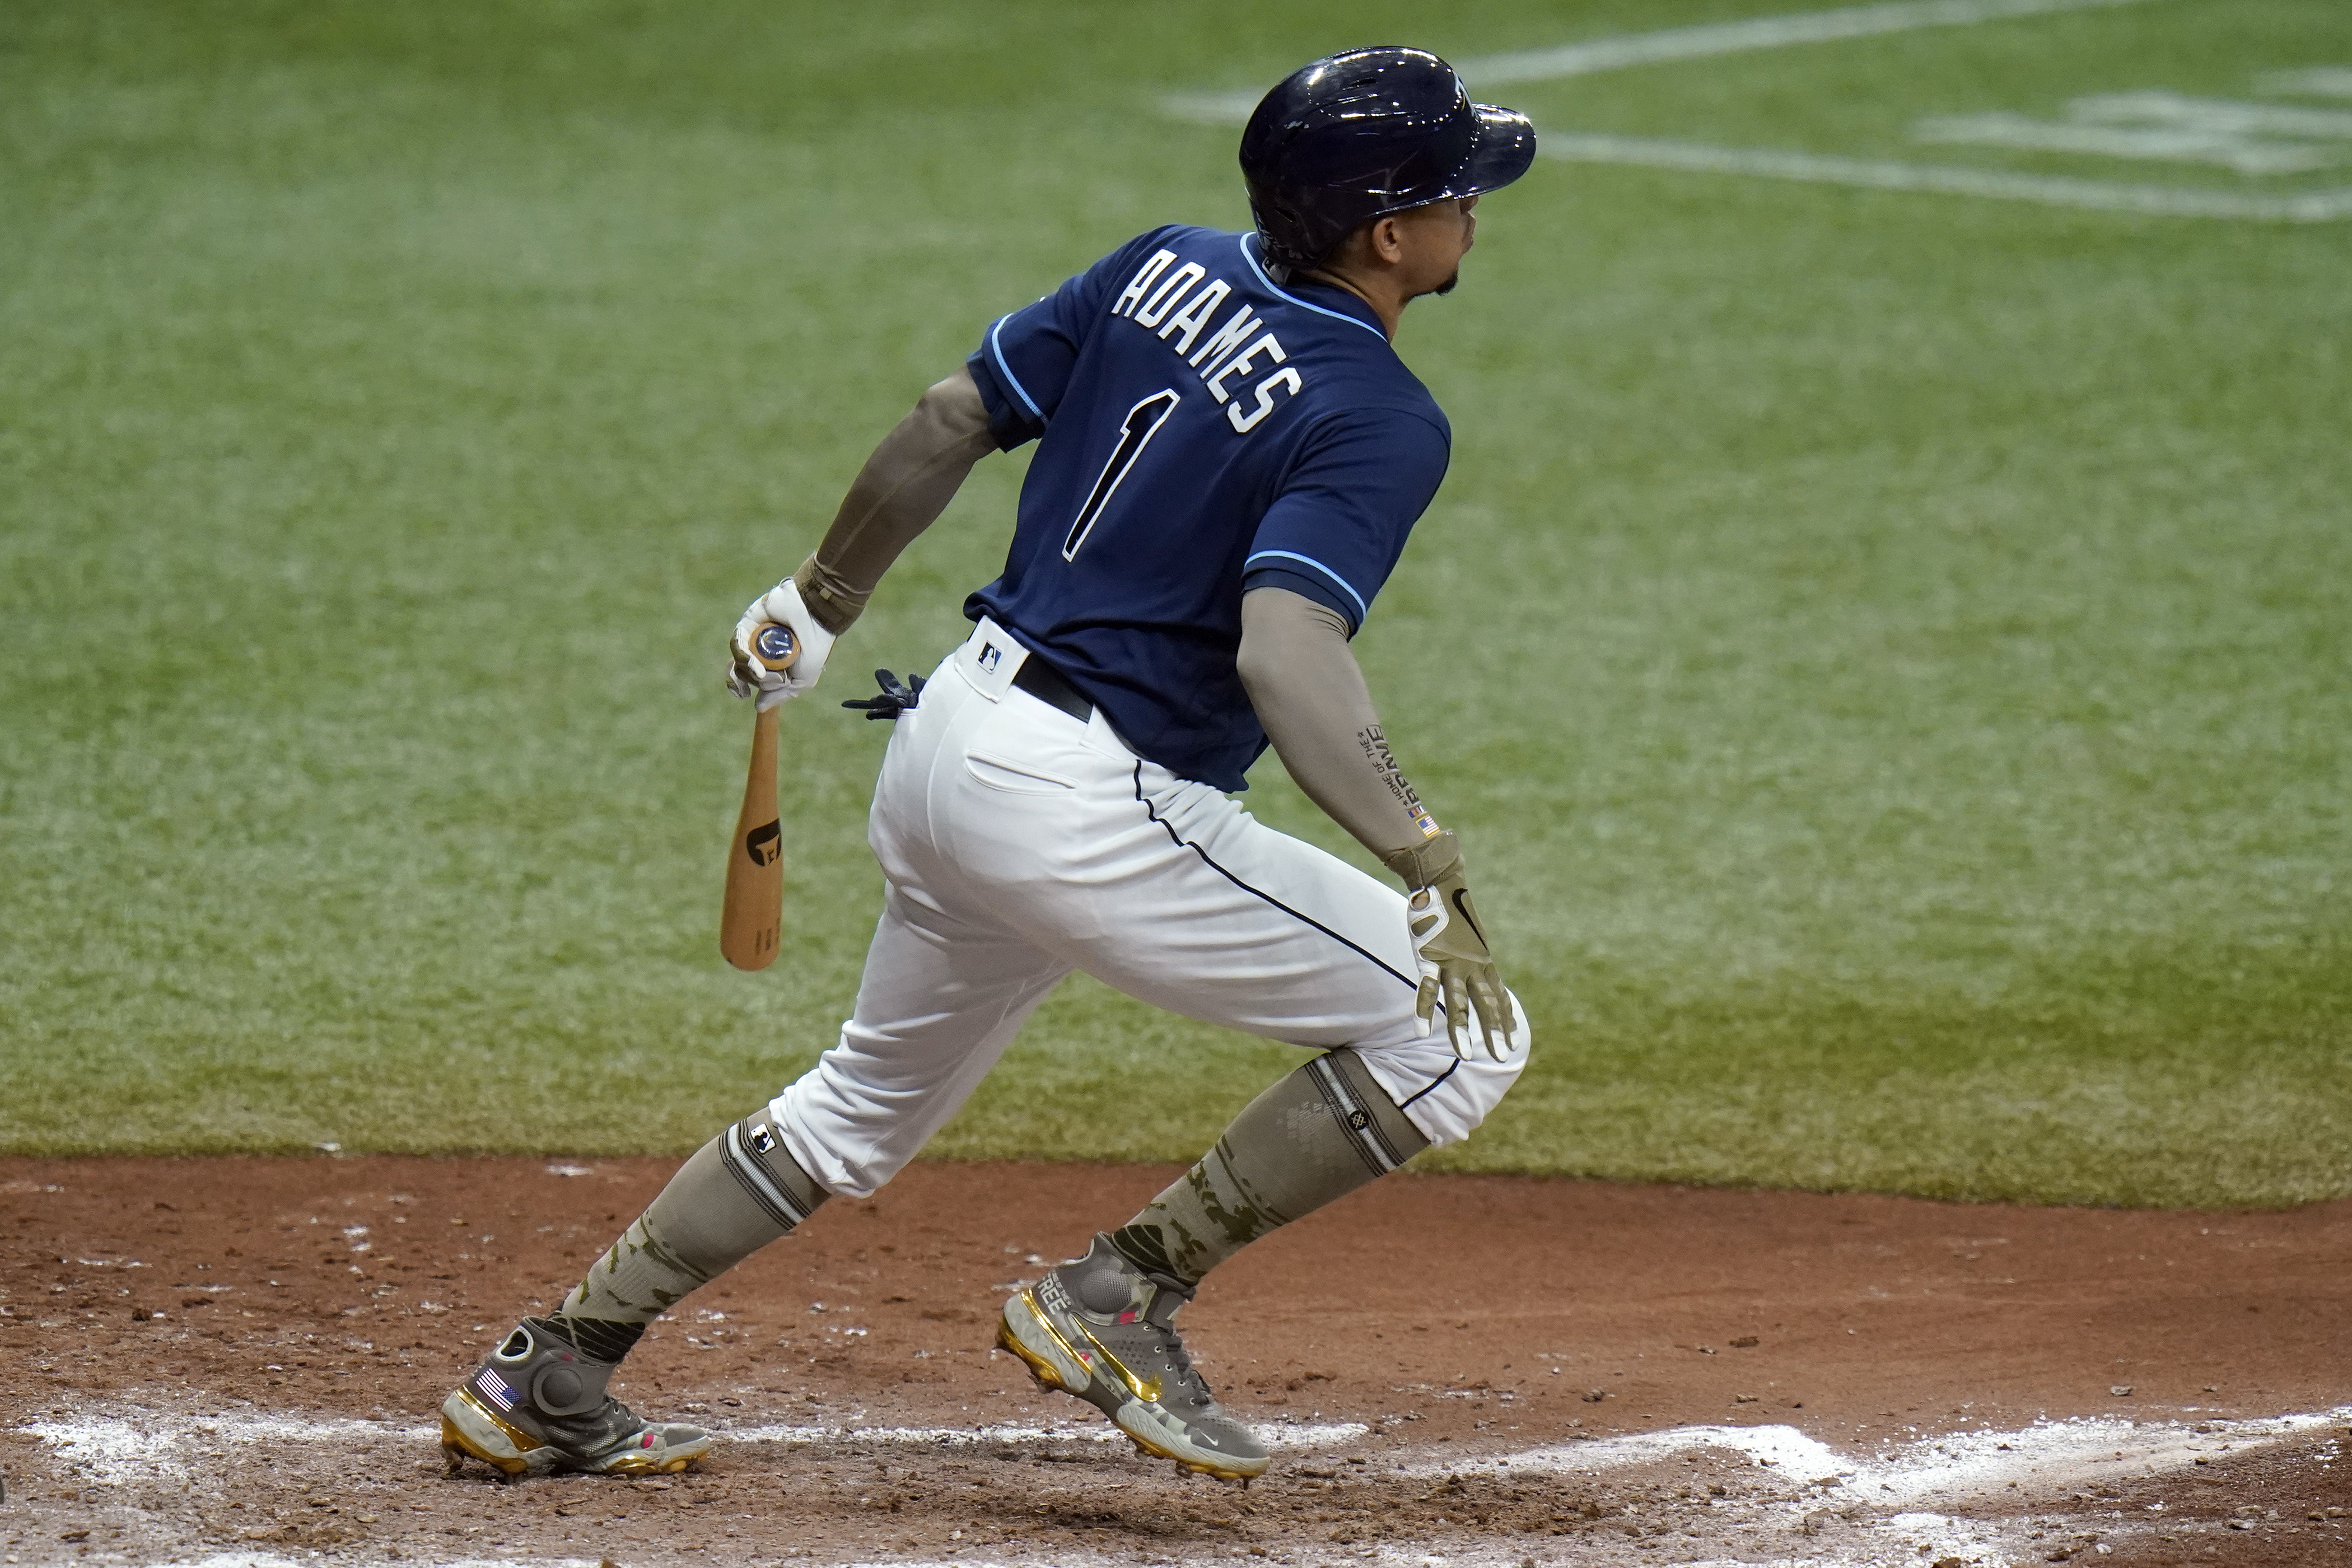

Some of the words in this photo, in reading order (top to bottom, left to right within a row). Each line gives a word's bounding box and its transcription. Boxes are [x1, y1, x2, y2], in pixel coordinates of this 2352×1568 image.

[1112, 249, 1302, 433] ADAMES
[1062, 388, 1180, 563] 1
[1359, 738, 1375, 758] THE
[1371, 762, 1385, 773] OF
[1382, 774, 1404, 800] HOME
